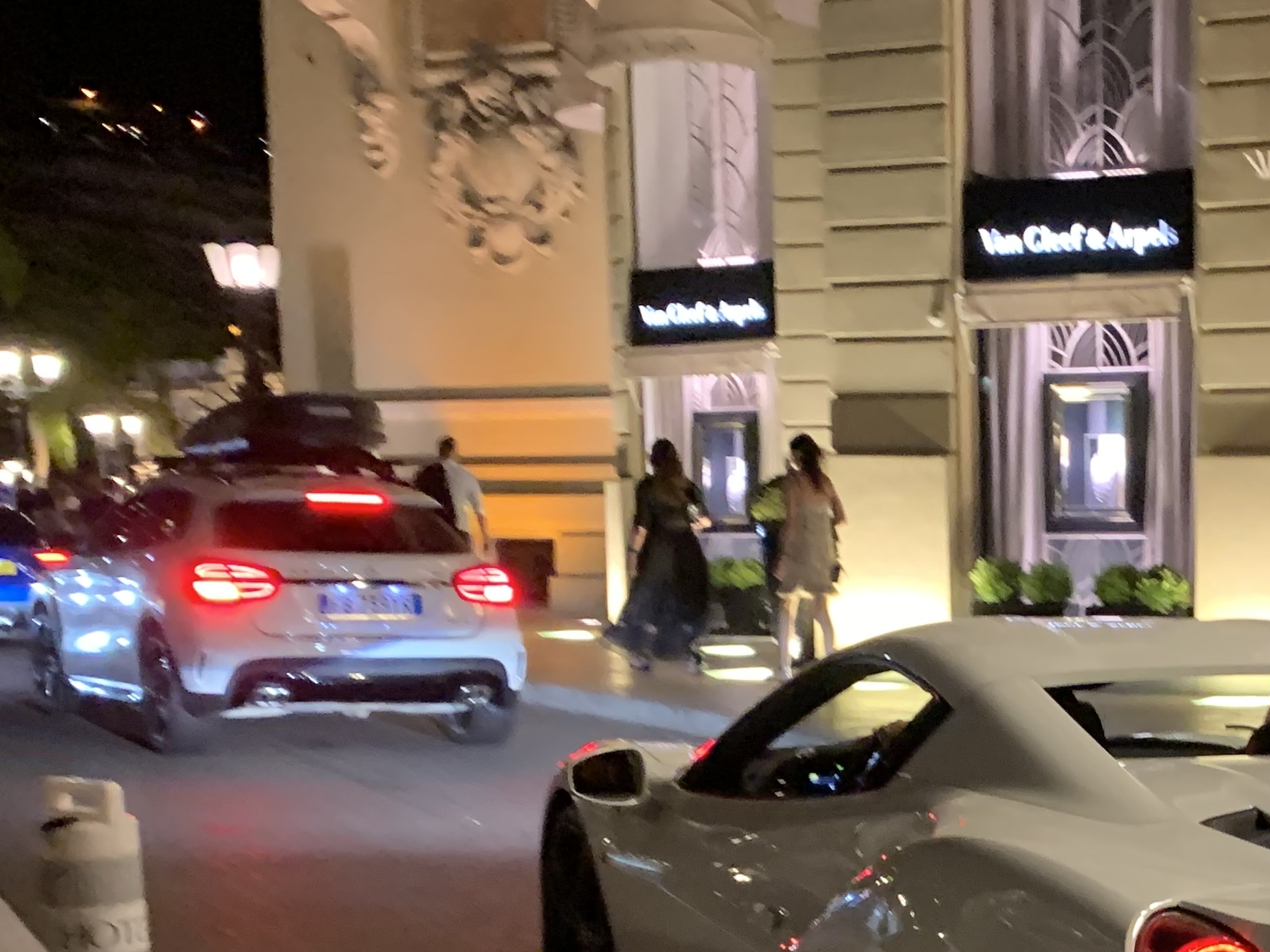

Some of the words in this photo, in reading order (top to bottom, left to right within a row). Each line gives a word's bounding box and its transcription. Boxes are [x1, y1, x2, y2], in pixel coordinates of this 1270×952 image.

[978, 227, 1024, 256] Van
[1023, 223, 1086, 254] Cleef
[1085, 226, 1107, 250] &
[1105, 218, 1180, 256] Arpels
